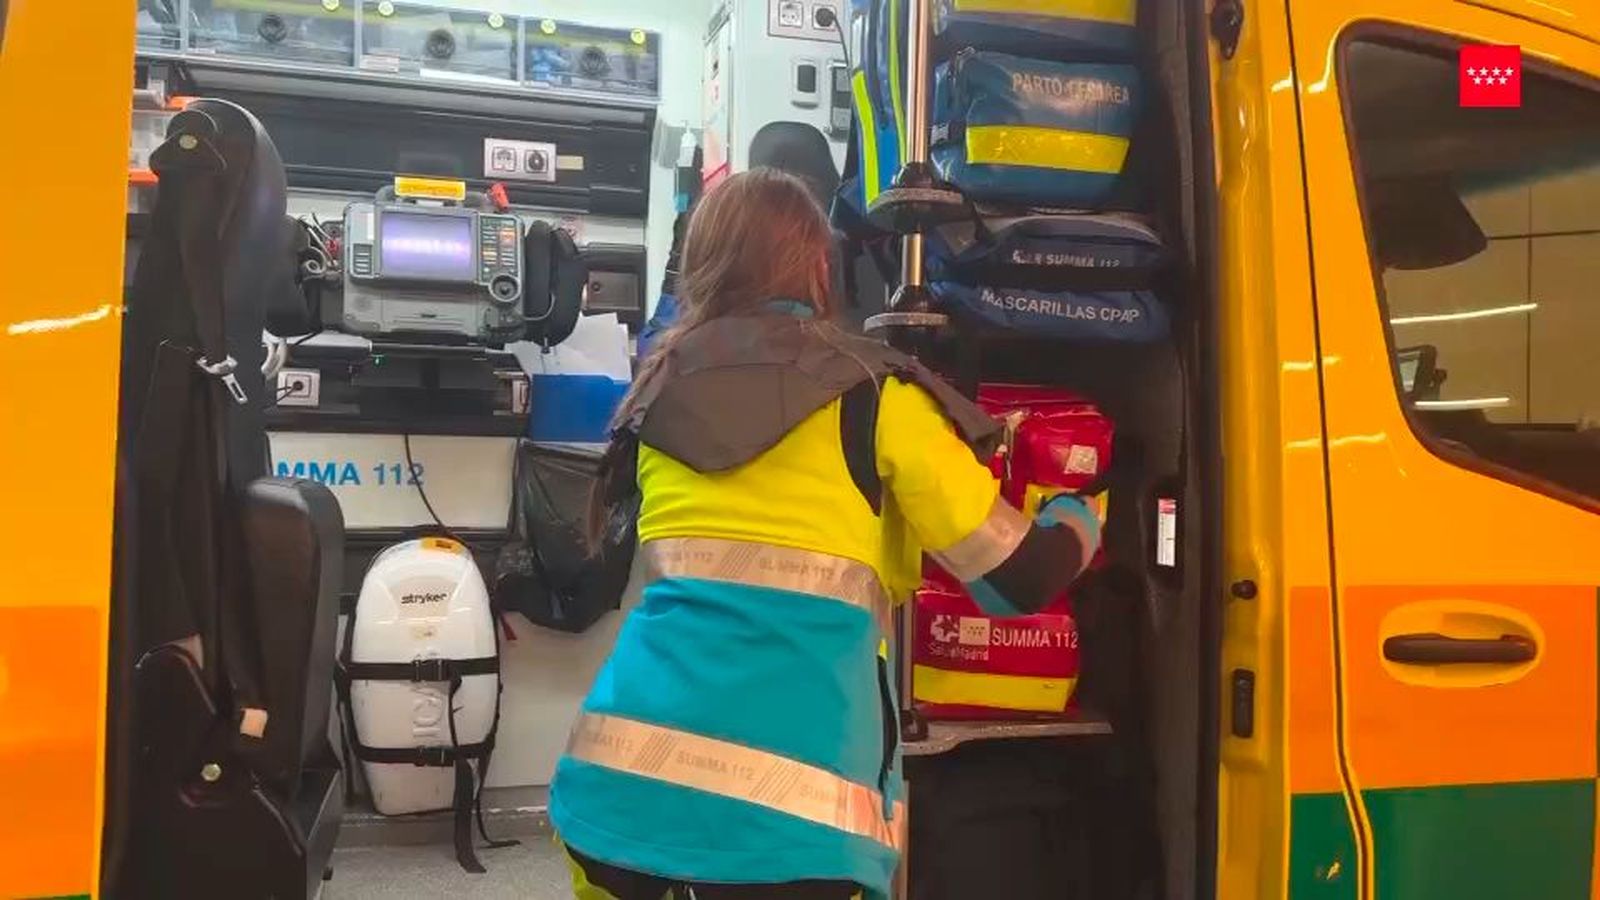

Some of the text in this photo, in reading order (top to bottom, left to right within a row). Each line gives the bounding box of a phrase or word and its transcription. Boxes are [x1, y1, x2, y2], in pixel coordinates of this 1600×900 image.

[980, 287, 1140, 323] MASCARILLAS CPAP
[373, 461, 424, 486] 112
[401, 592, 447, 604] stryker
[991, 626, 1079, 649] SUMMA 112
[676, 750, 756, 782] SUMMA 112
